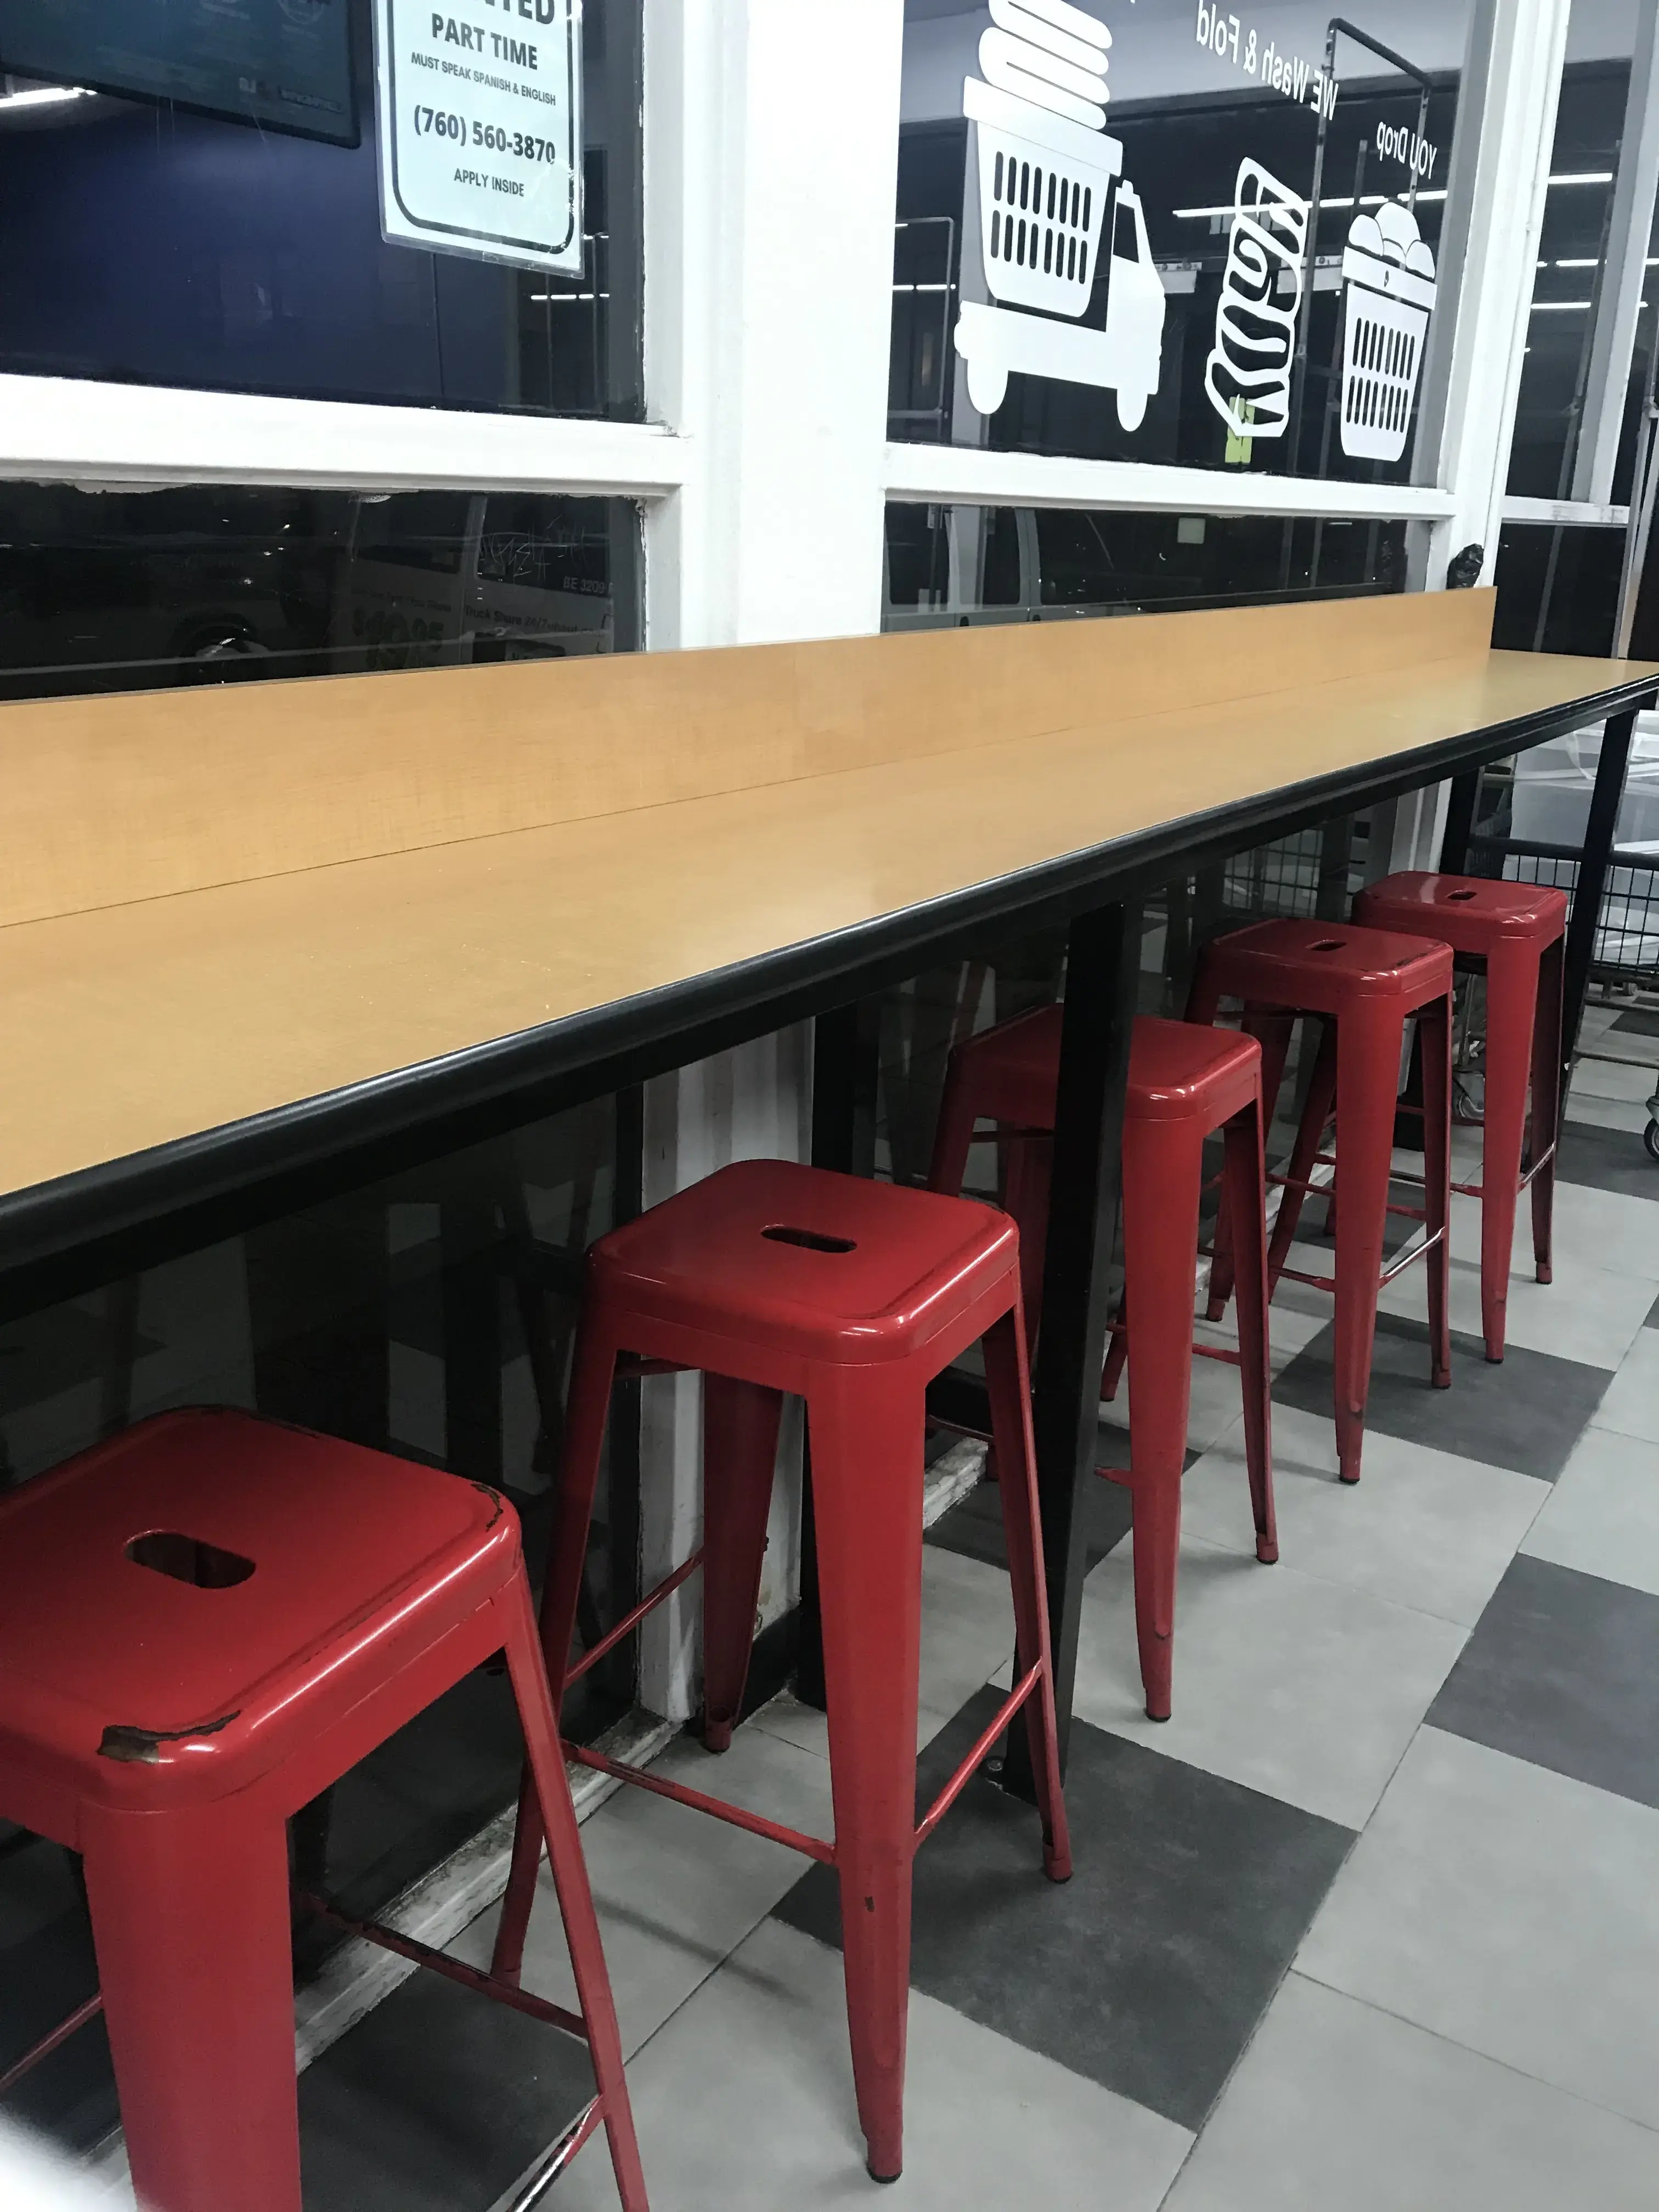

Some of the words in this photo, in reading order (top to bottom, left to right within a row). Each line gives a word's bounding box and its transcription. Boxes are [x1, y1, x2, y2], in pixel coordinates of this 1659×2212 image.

[432, 13, 485, 53] PART
[490, 32, 538, 70] TIME
[411, 52, 440, 71] MUST
[442, 62, 471, 81] SPEAK
[473, 71, 511, 93] SPANISH
[514, 83, 519, 95] &
[521, 85, 556, 106] ENGLISH
[414, 104, 467, 147] (760)
[472, 121, 556, 165] 560-3870
[454, 168, 488, 188] APPLY
[492, 177, 524, 197] INSIDE
